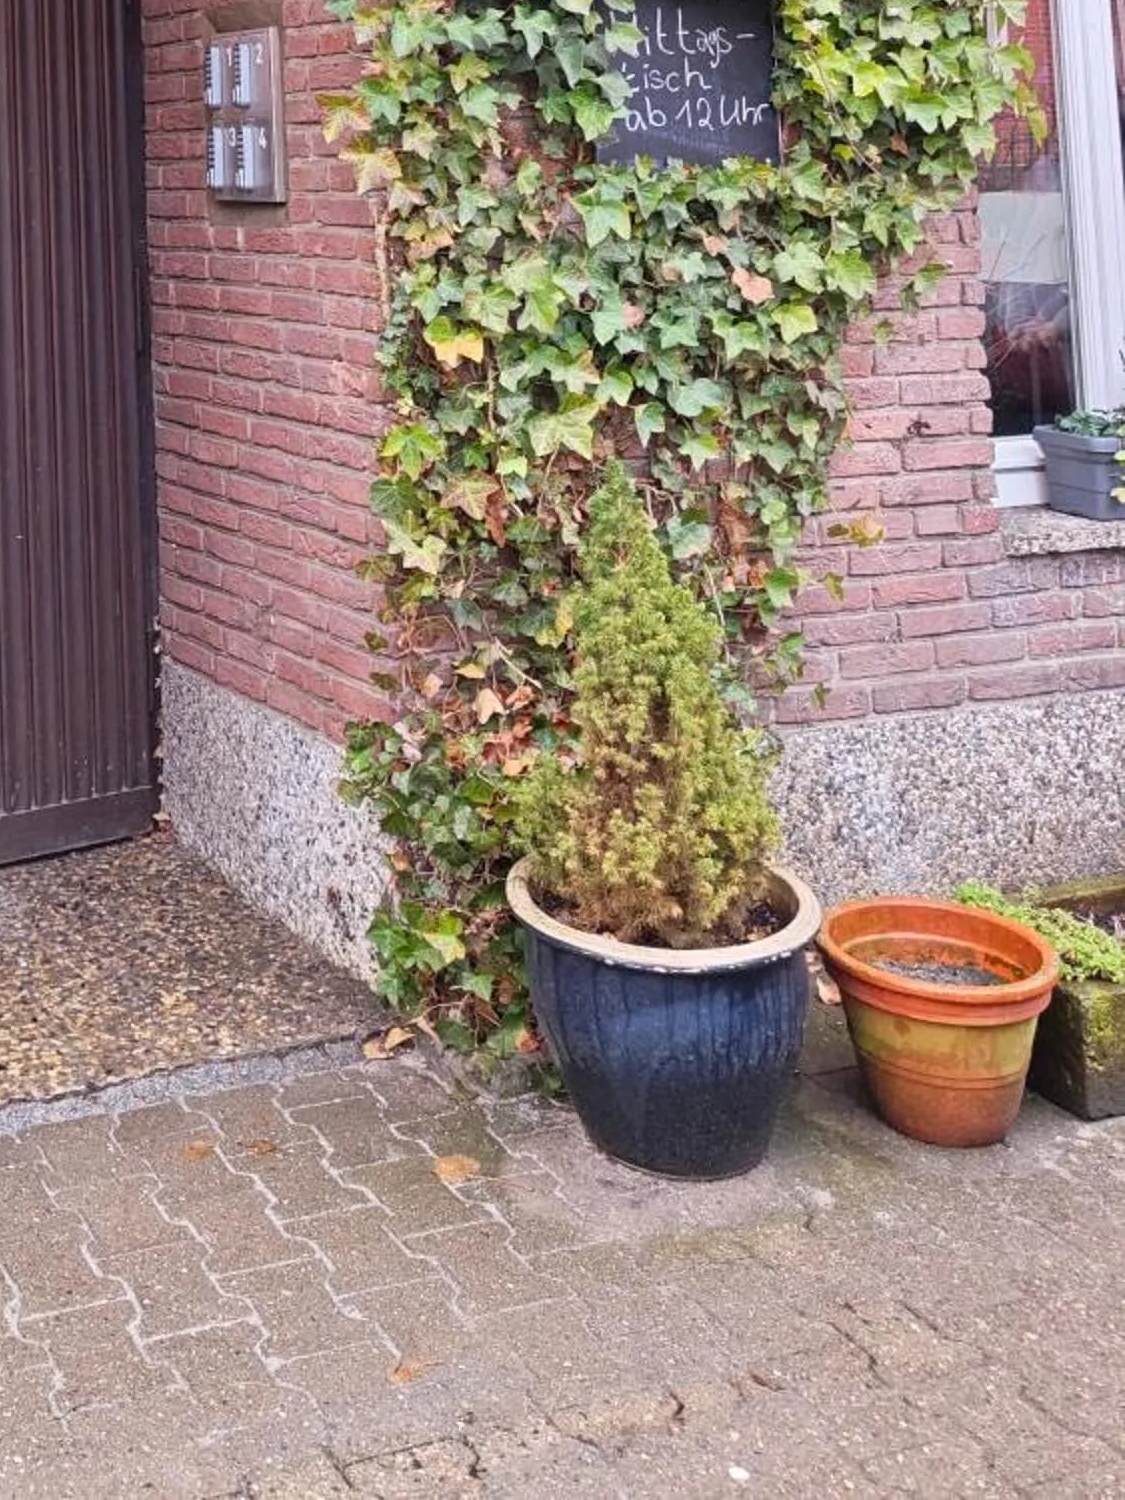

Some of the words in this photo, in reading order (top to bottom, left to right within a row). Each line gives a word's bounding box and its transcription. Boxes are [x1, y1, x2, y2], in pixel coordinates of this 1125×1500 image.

[255, 42, 264, 65] 2
[625, 96, 667, 132] ab
[675, 98, 714, 131] 12
[719, 95, 770, 127] Uhr
[258, 126, 268, 150] 4
